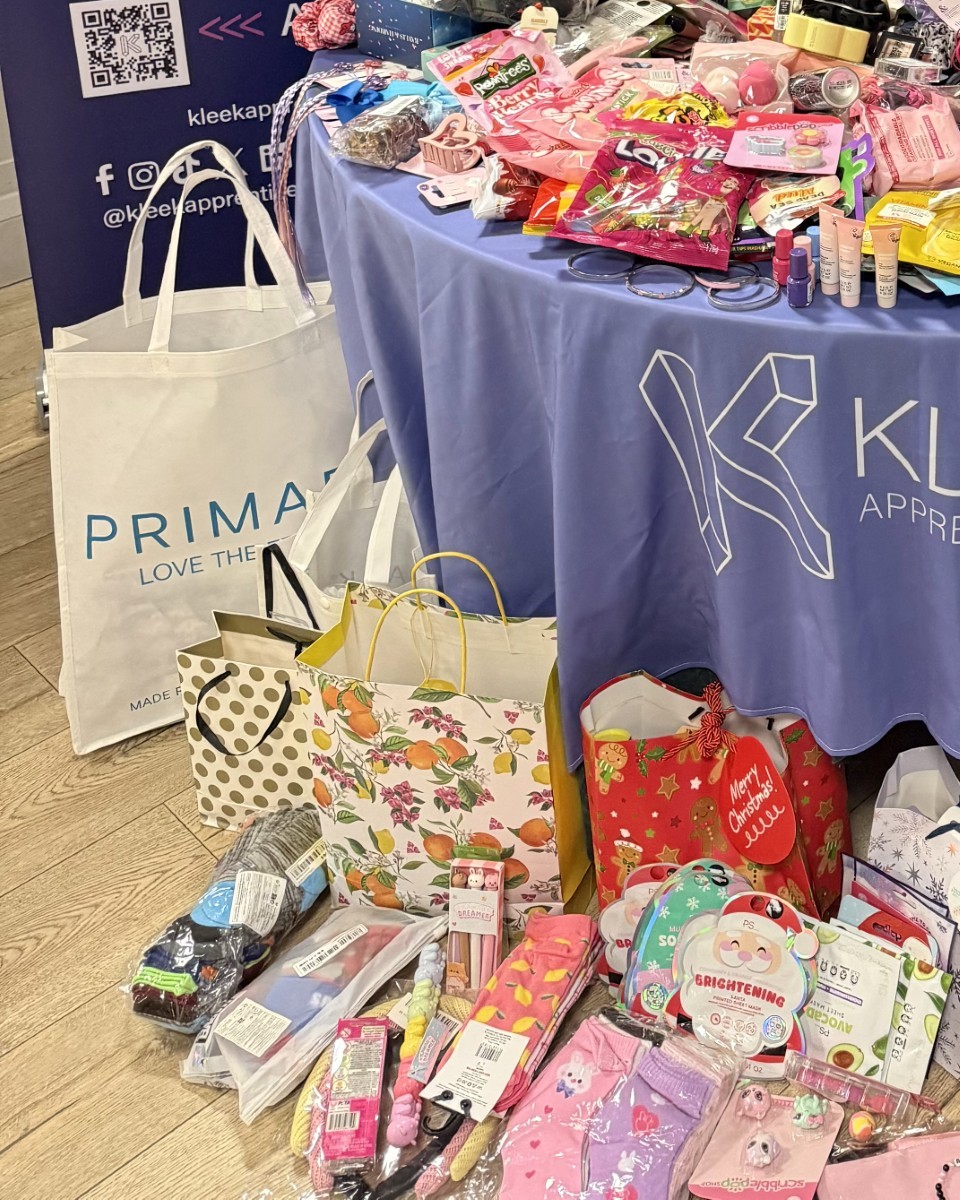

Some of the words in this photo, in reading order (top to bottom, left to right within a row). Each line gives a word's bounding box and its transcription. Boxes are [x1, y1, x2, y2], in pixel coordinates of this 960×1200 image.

[489, 79, 540, 111] Berry
[139, 556, 205, 587] LOVE
[211, 544, 257, 569] THE
[129, 689, 171, 712] MADE
[729, 765, 778, 834] Christmas!
[730, 763, 761, 805] Merry
[458, 910, 490, 919] DREAMER
[695, 974, 786, 1008] BRIGHTENING
[713, 995, 733, 1004] PRINTED
[721, 1177, 806, 1192] scribblepop
